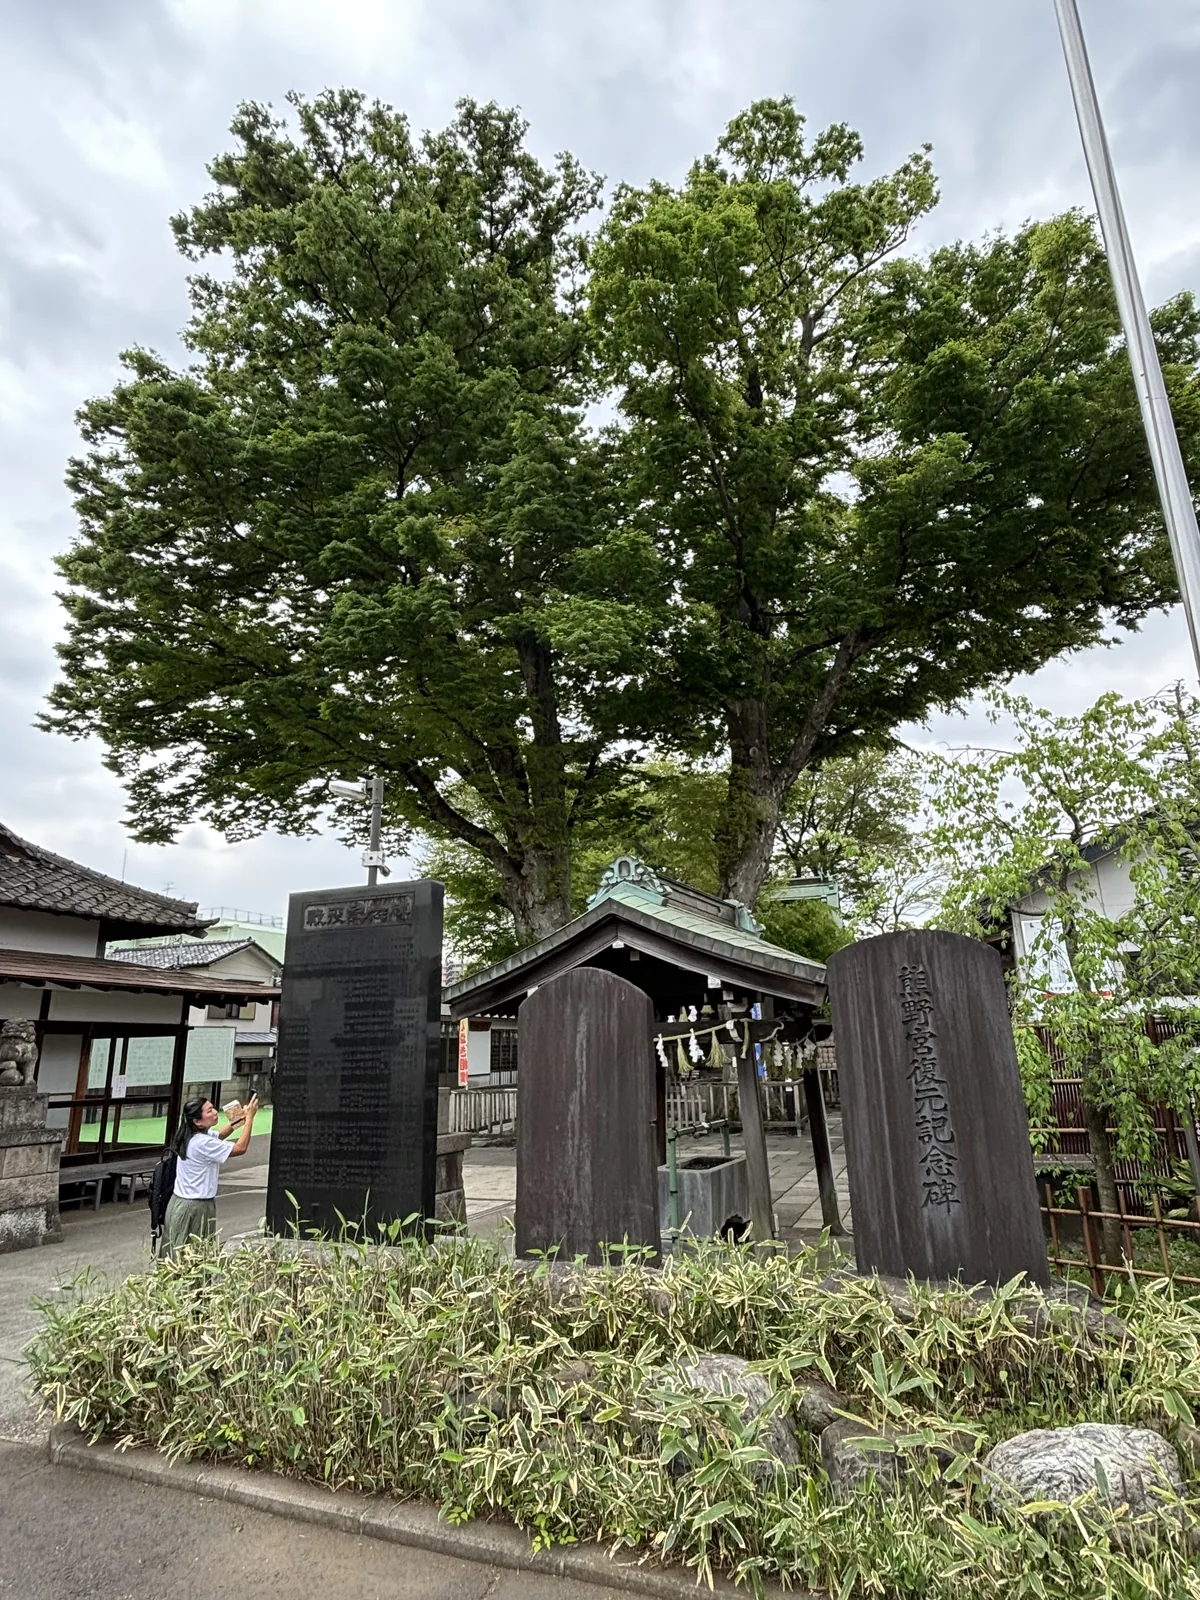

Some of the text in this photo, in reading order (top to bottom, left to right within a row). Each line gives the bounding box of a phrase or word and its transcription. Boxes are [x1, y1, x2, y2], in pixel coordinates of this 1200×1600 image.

[899, 966, 961, 1214] 熊野宮復元記念碑
